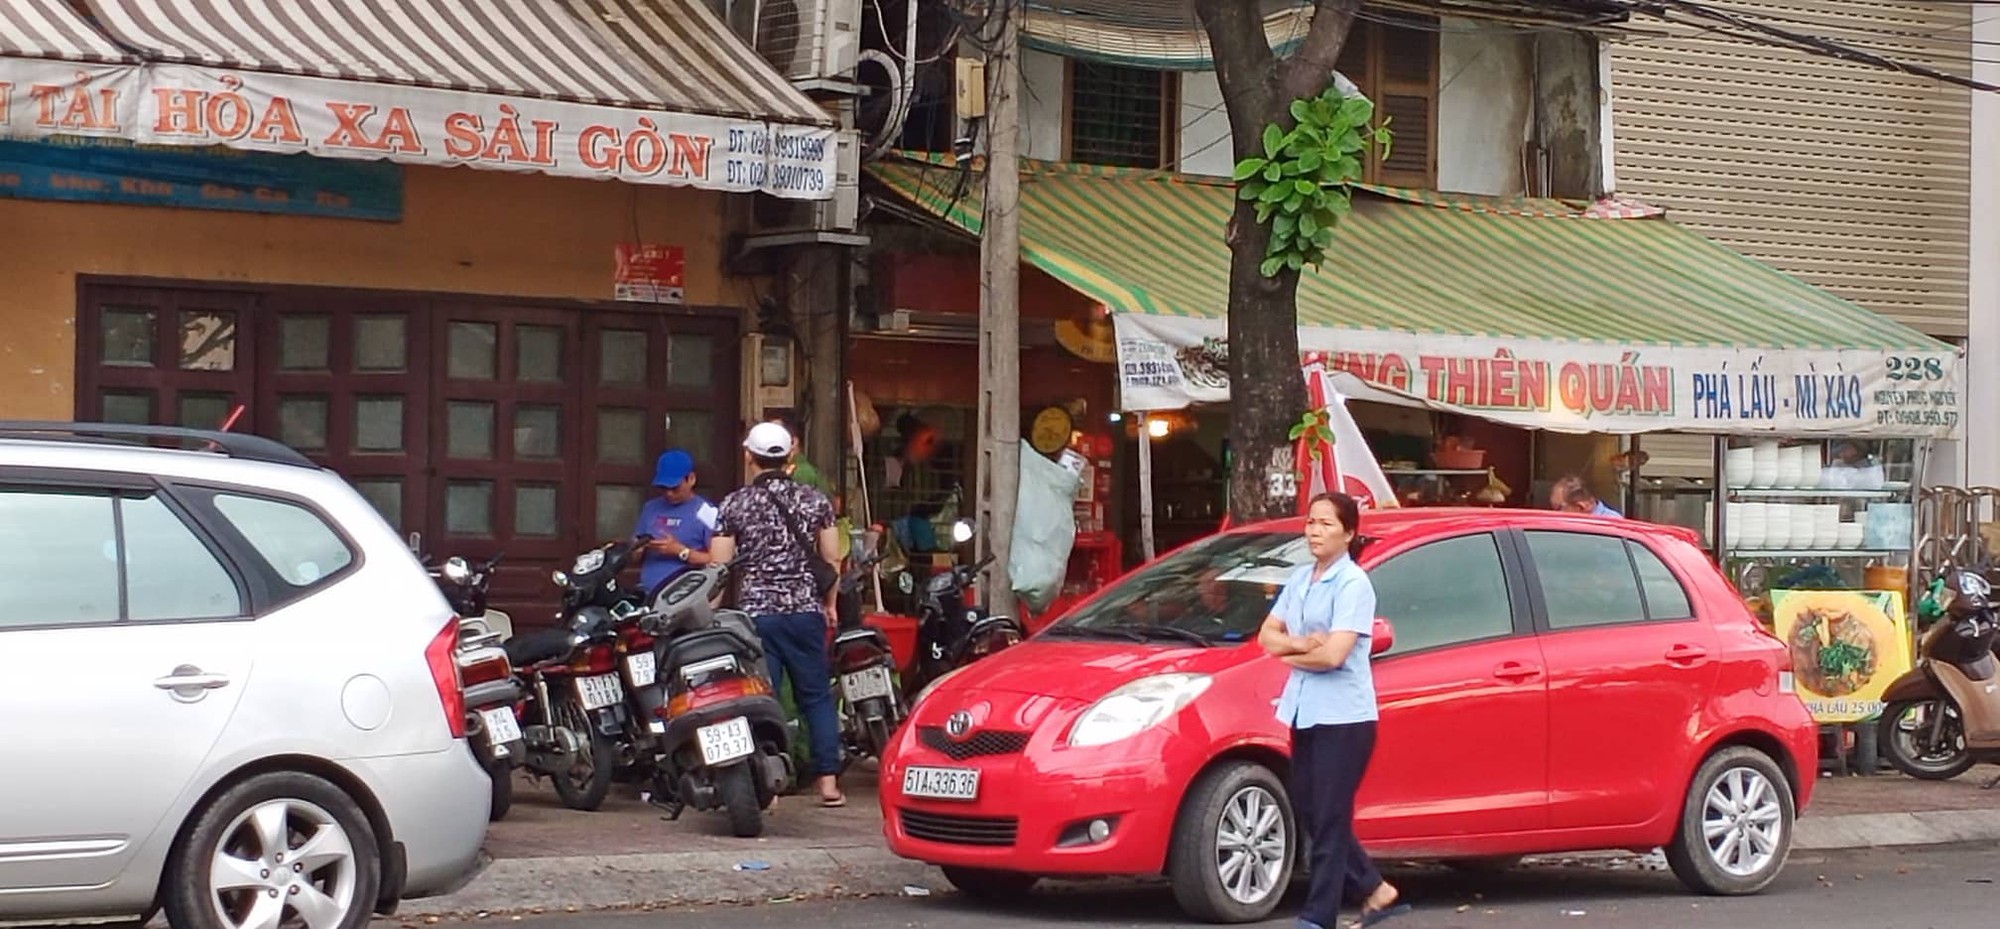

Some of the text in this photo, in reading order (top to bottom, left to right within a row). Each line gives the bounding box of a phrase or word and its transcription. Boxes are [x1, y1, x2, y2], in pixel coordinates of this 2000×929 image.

[29, 71, 120, 132] TẢI
[152, 74, 308, 146] HỎA
[323, 101, 427, 156] XA
[444, 103, 559, 167] SÀI
[577, 116, 715, 181] GÒN
[1419, 347, 1551, 411] THIÊN
[1558, 351, 1675, 420] QUÁN
[1692, 360, 1732, 419] PHÁ
[1738, 355, 1776, 419] LẤU
[1794, 361, 1818, 419] MÌ
[1823, 361, 1862, 419] XÀO
[1885, 356, 1944, 382] 228
